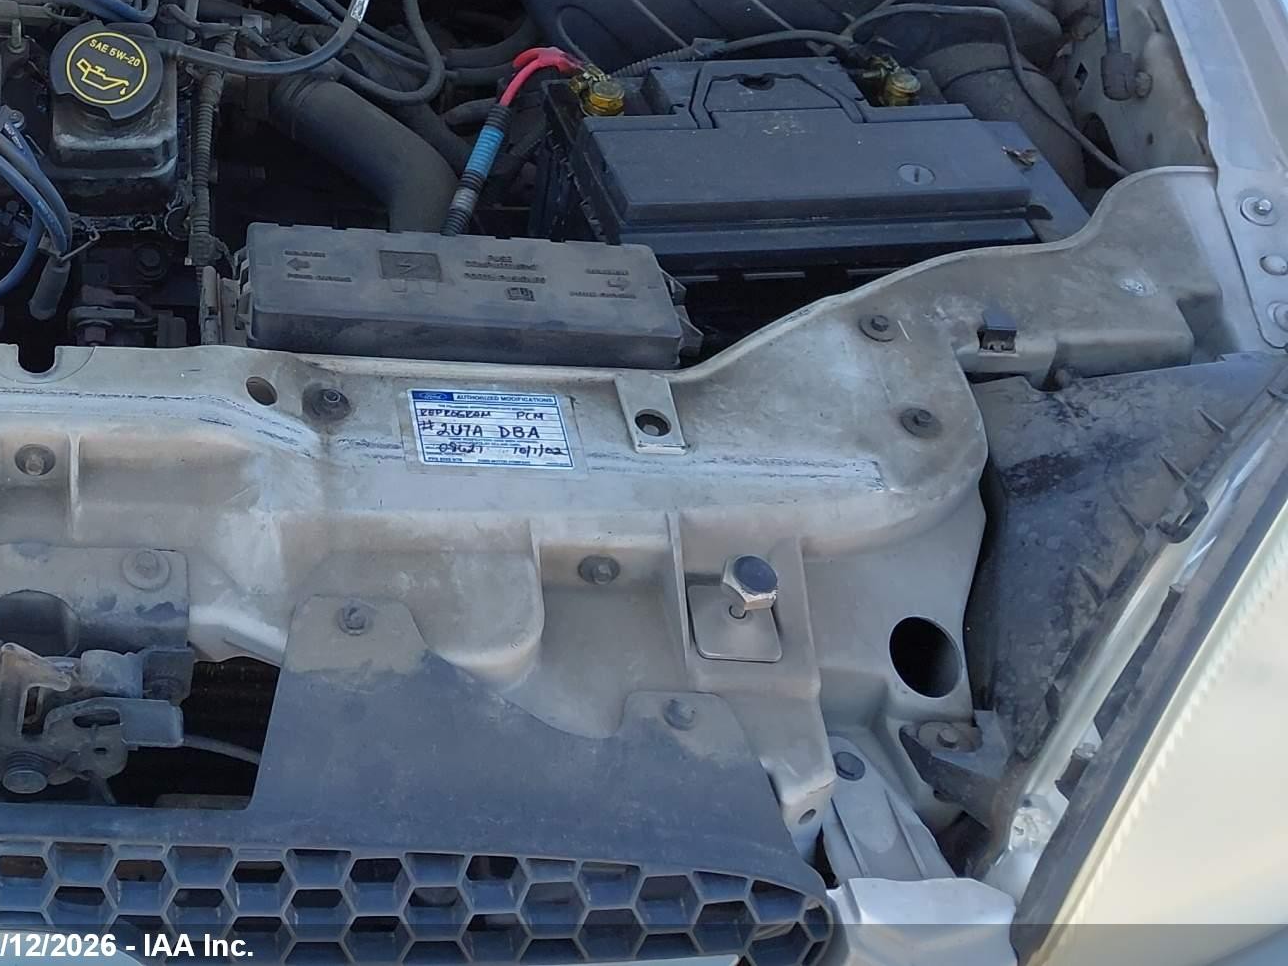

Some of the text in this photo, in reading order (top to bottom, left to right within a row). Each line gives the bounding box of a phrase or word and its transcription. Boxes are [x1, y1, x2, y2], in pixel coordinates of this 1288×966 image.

[89, 38, 141, 67] SAE 5W-20
[500, 396, 554, 404] MODIFICATIONS
[516, 410, 544, 421] PCM
[498, 425, 541, 439] DBA
